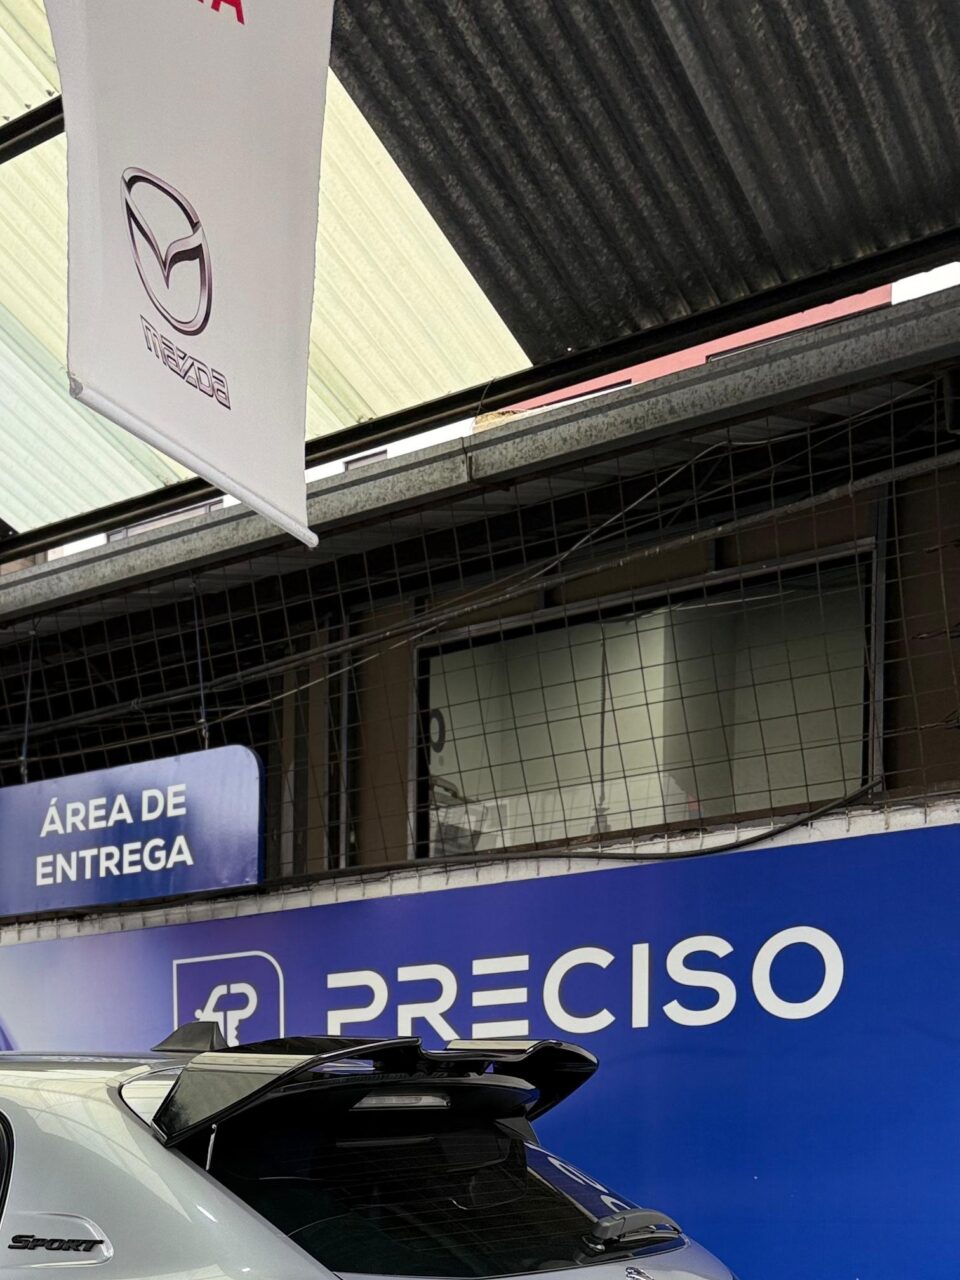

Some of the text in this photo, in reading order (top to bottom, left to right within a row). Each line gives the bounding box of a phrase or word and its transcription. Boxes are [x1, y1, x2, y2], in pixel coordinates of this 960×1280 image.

[40, 783, 186, 837] ÁREA DE
[36, 835, 194, 887] ENTREGA
[327, 925, 844, 1041] PRECISO
